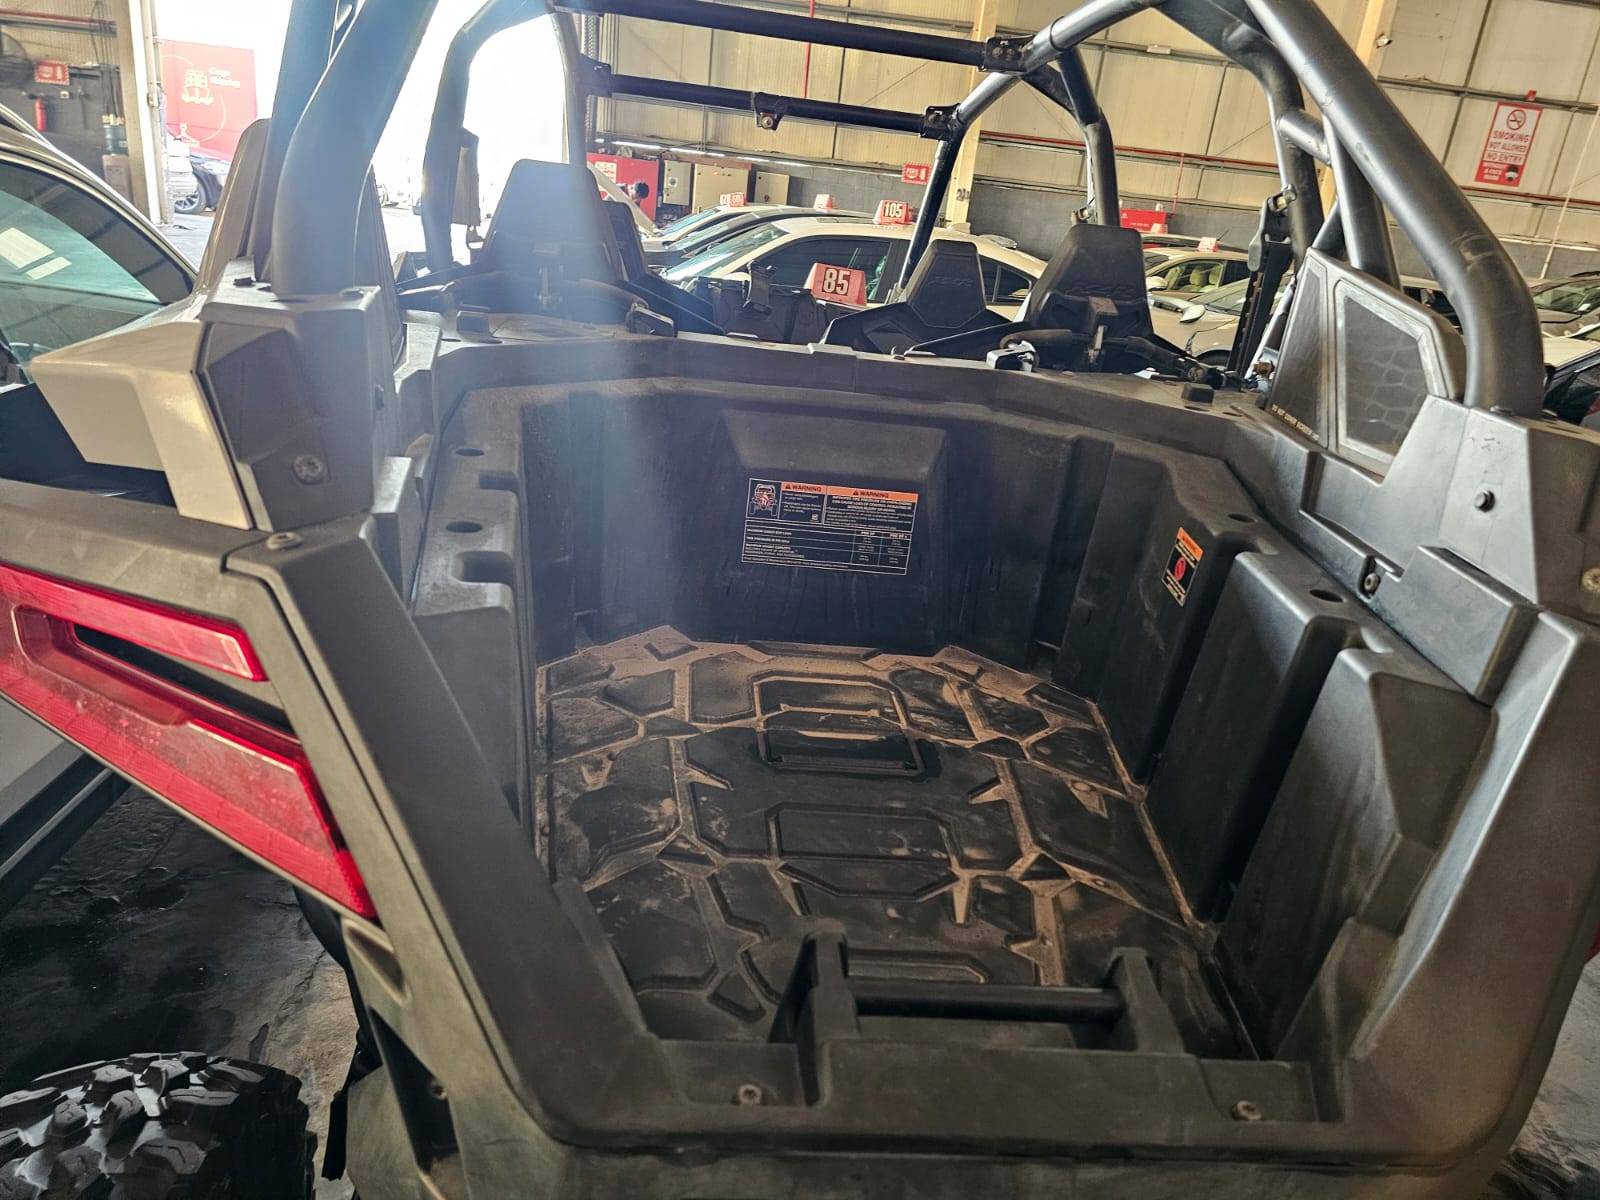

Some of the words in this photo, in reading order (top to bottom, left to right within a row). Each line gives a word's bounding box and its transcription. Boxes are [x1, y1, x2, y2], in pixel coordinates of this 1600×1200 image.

[1493, 130, 1530, 143] SMOKING
[1489, 141, 1501, 150] NOT
[1502, 143, 1528, 153] ALLOWED
[1487, 152, 1498, 161] NO
[1499, 153, 1523, 163] ENTRY
[883, 201, 903, 218] 105
[822, 267, 851, 296] 85
[792, 484, 822, 493] WARNING
[860, 490, 889, 499] WARNING
